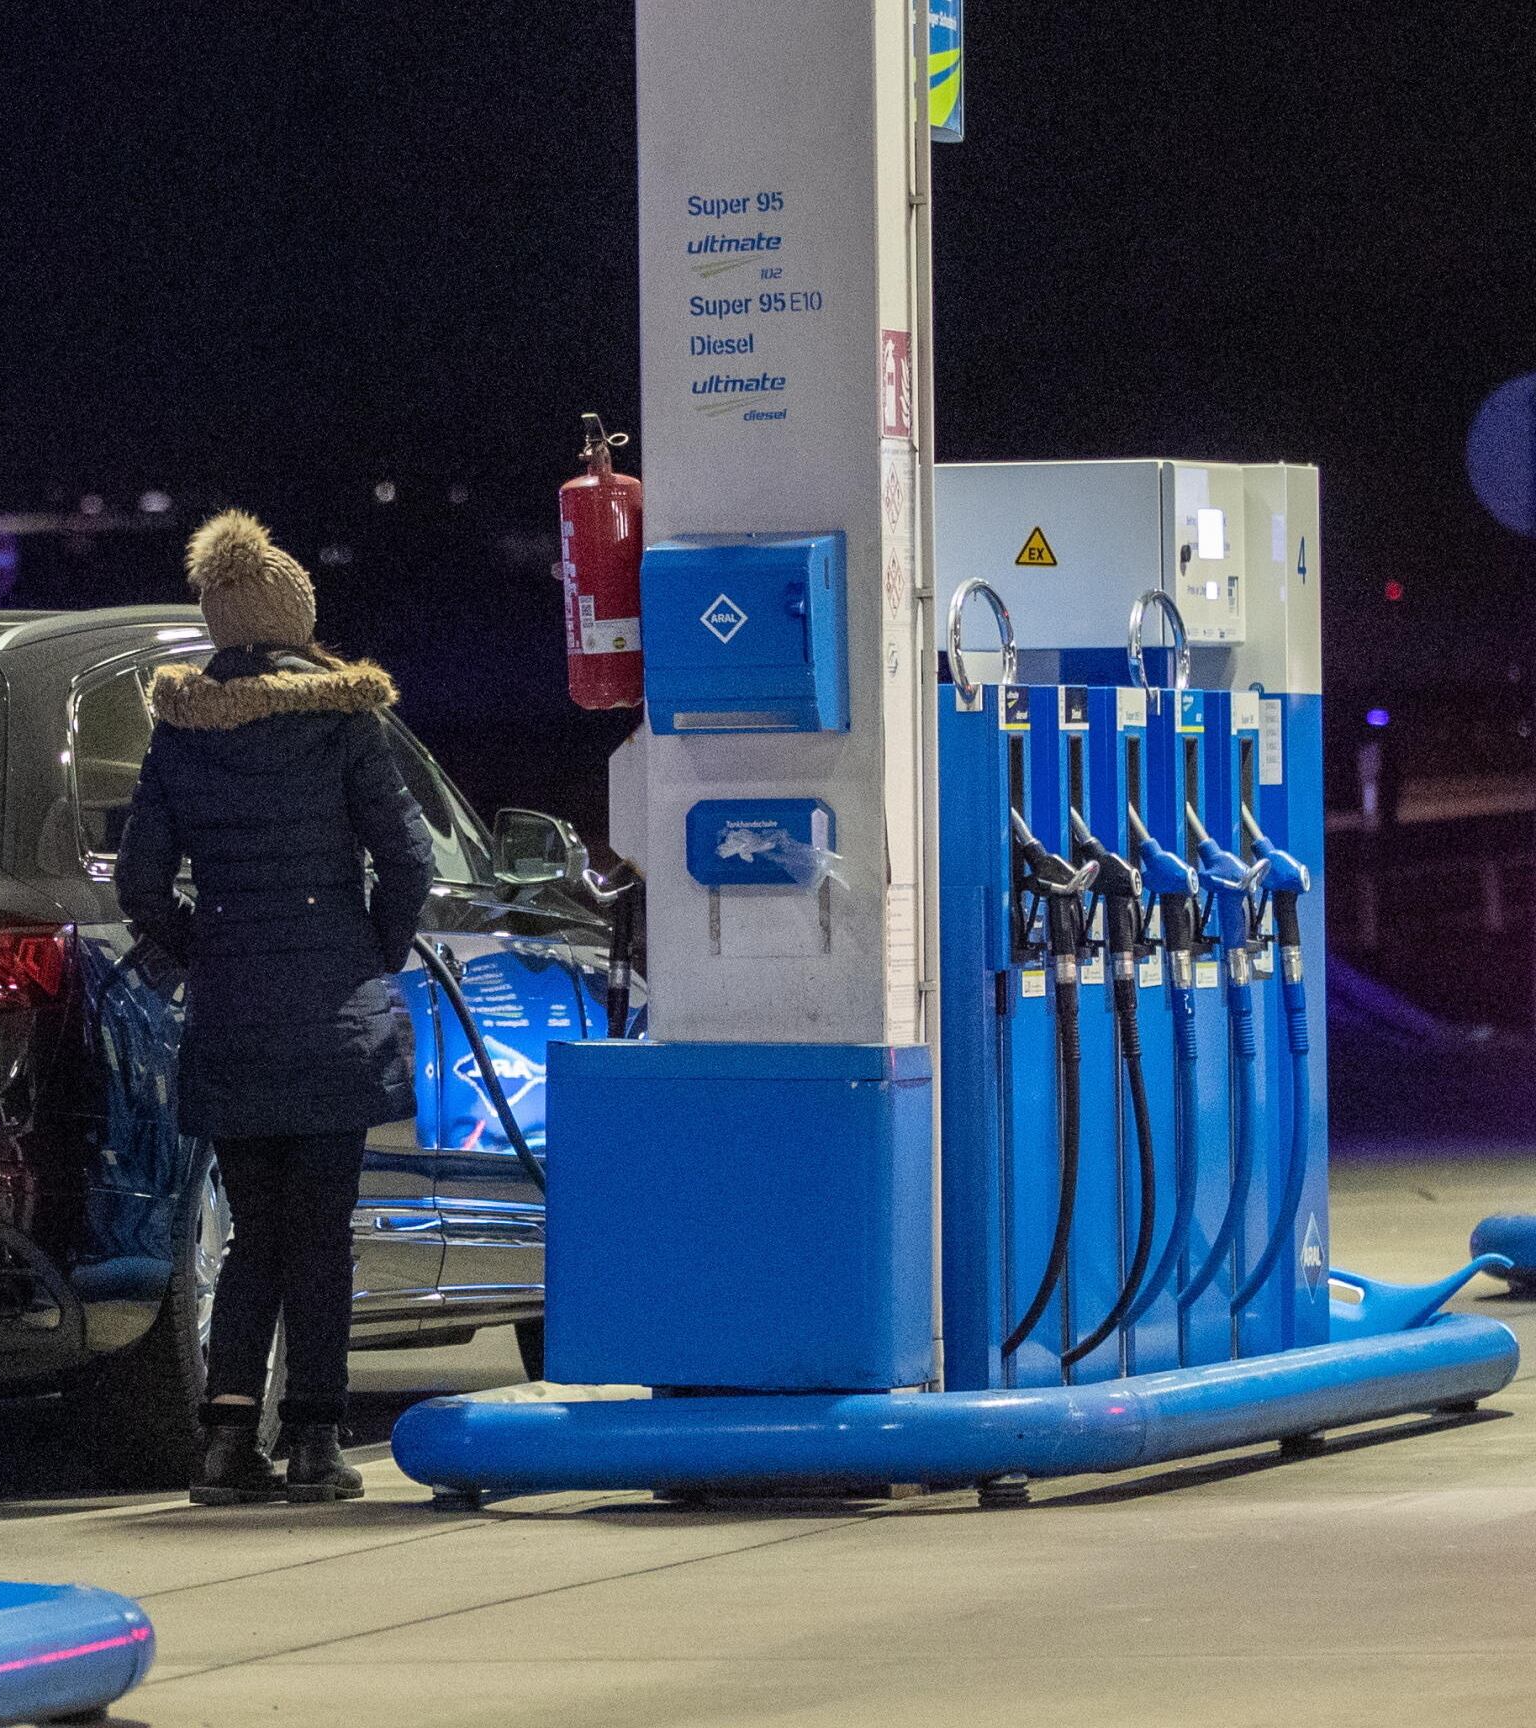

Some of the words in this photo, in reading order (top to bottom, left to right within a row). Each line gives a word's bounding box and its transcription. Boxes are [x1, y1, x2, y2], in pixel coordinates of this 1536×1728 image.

[687, 195, 751, 219] Super
[756, 191, 784, 212] 95
[687, 231, 783, 255] ultimate
[760, 267, 783, 281] 102
[689, 295, 753, 319] Super
[758, 292, 787, 312] 95
[789, 292, 823, 312] E10
[690, 333, 755, 356] Diesel
[691, 372, 787, 395] ultimate
[743, 408, 788, 422] diesel
[1027, 547, 1045, 561] EX
[1296, 535, 1308, 584] 4
[710, 613, 738, 623] ARAL
[1302, 1245, 1322, 1267] ARAL
